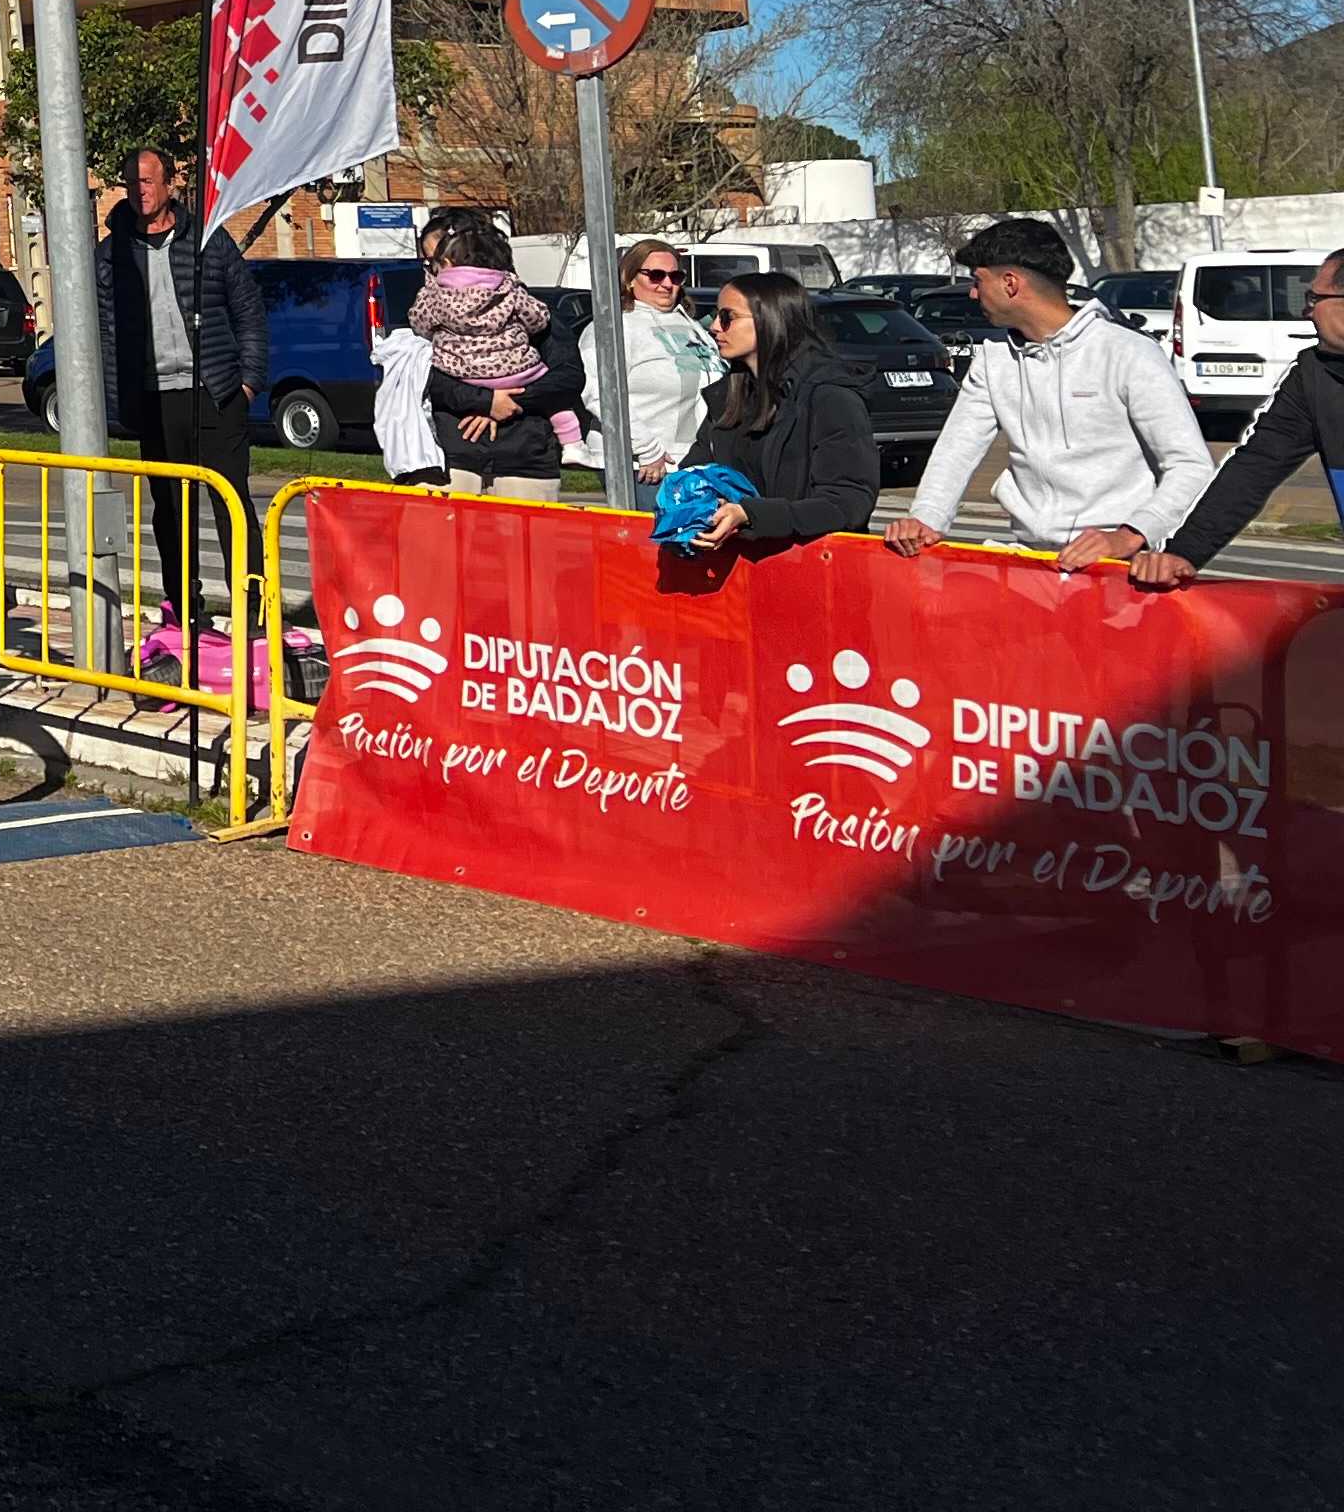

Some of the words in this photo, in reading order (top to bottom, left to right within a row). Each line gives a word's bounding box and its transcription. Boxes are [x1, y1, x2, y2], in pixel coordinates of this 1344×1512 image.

[463, 632, 683, 702] DIPUTACIÓN
[460, 680, 497, 711] DE
[506, 678, 683, 743] BADAJOZ
[952, 697, 1271, 788] DIPUTACIÓN
[440, 740, 506, 784] por
[517, 747, 553, 788] el
[552, 747, 694, 813] Deporte
[951, 755, 999, 796] DE
[1013, 755, 1269, 840] BADAJOZ
[931, 830, 1017, 882] por
[1031, 840, 1079, 892] el
[1081, 842, 1277, 925] Deporte
